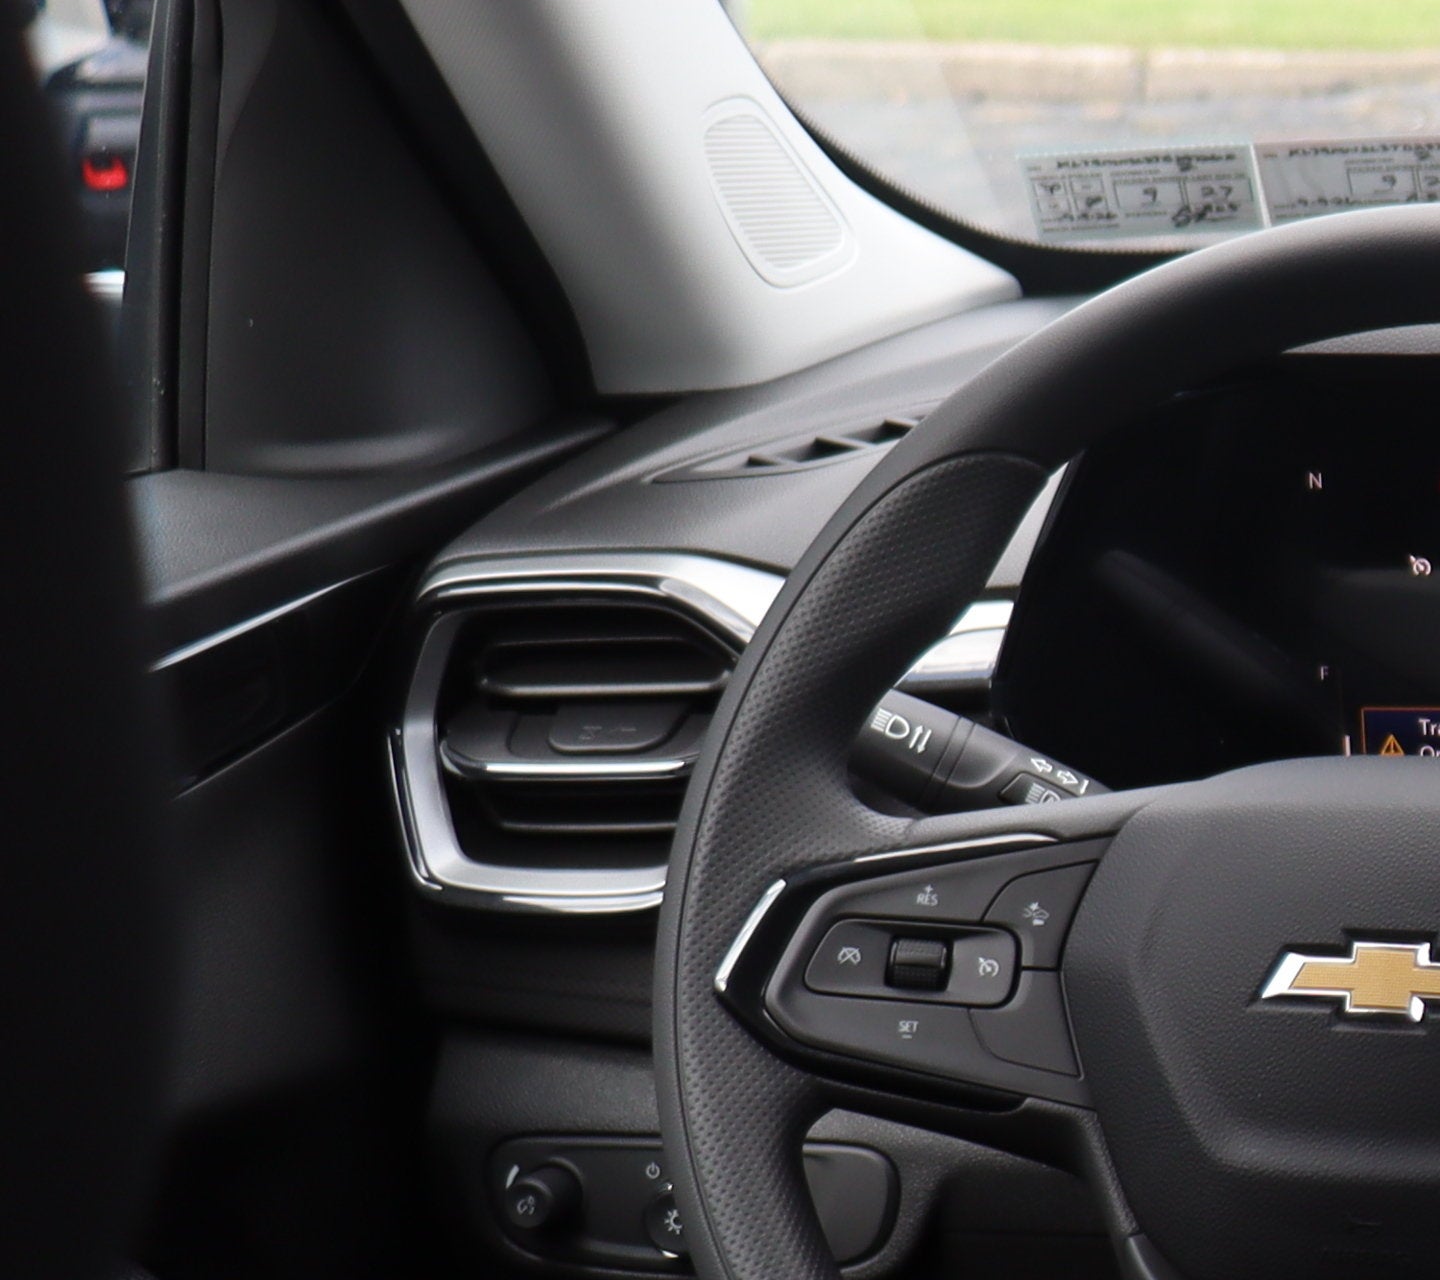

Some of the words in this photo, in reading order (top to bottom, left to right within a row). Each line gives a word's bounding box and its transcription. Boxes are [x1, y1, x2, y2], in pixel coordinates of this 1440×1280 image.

[1309, 472, 1323, 489] N
[916, 893, 939, 907] RES
[899, 1020, 919, 1033] SET
